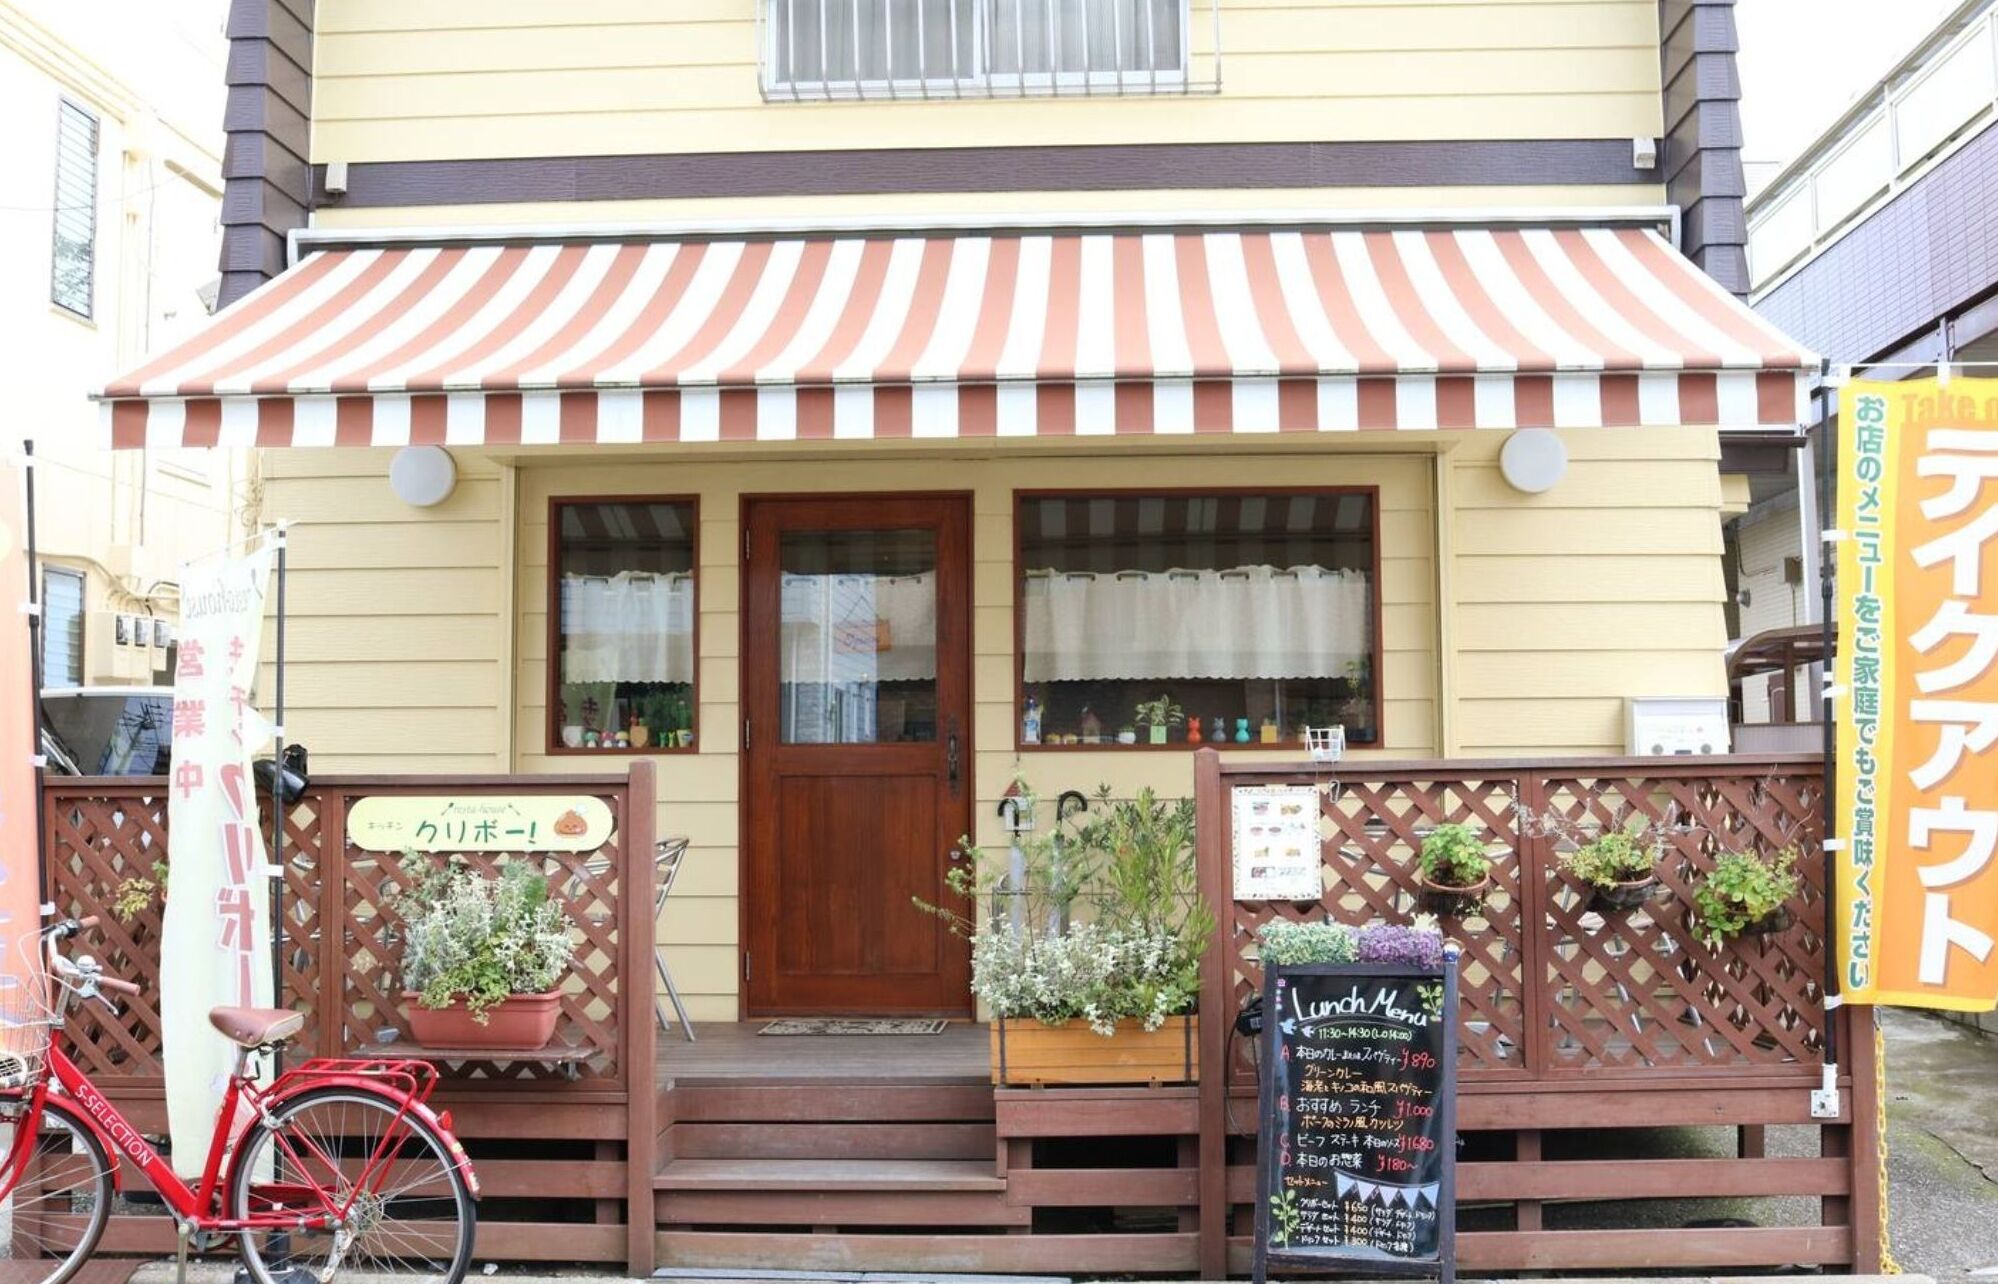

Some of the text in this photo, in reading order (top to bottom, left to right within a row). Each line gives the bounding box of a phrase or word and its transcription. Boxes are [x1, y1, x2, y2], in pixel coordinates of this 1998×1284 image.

[1850, 396, 1885, 988] お店のメニューをご家庭でもご賞味ください
[1907, 428, 1998, 985] テイクアウト
[416, 819, 537, 844] クリボー!
[1291, 985, 1428, 1027] Lunch Menu
[74, 1084, 153, 1167] S-SELECTION
